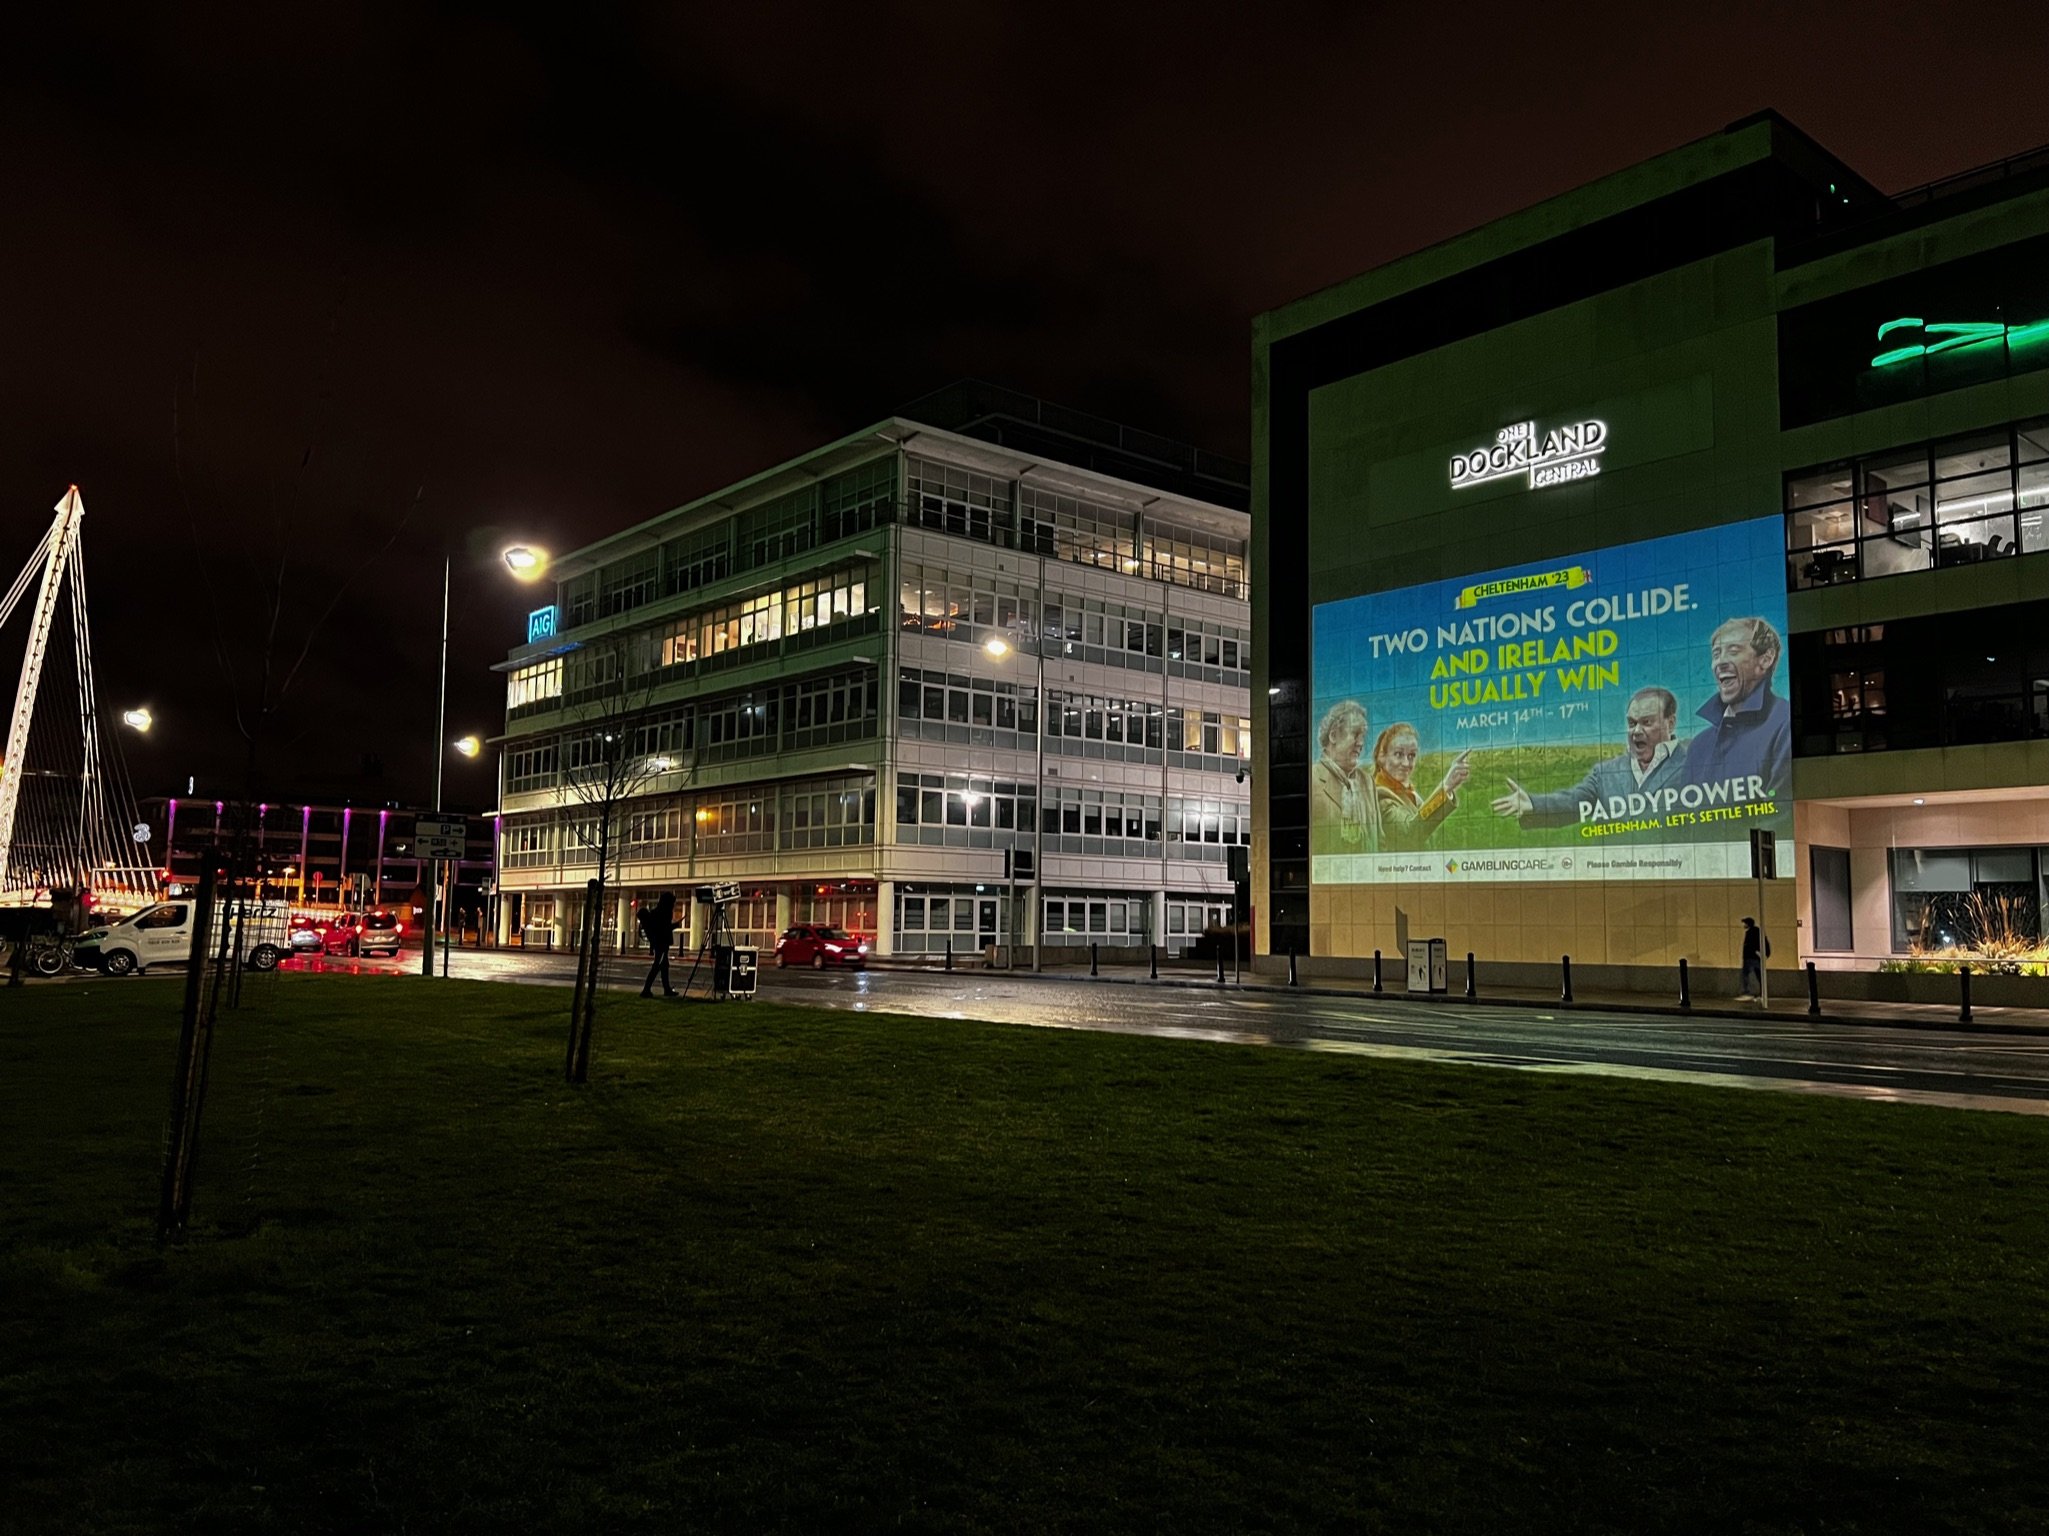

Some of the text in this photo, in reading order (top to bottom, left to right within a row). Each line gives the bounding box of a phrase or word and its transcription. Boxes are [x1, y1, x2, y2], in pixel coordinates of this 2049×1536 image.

[1498, 423, 1528, 442] ONE
[1451, 421, 1605, 481] DOCKLAND
[1535, 459, 1600, 487] CENTRAL
[1474, 571, 1569, 597] CHELTENHAM '23
[532, 614, 550, 637] AIG
[1368, 584, 1698, 658] TWO NATIONS COLLIDE.
[1430, 629, 1618, 680] AND IRELAND
[1430, 661, 1619, 709] USUALLY WIN
[1456, 711, 1508, 730] MARCH
[1581, 802, 1779, 838] CHELTENHAM. LET'S SETTLE THIS.
[1409, 864, 1432, 873] Contact
